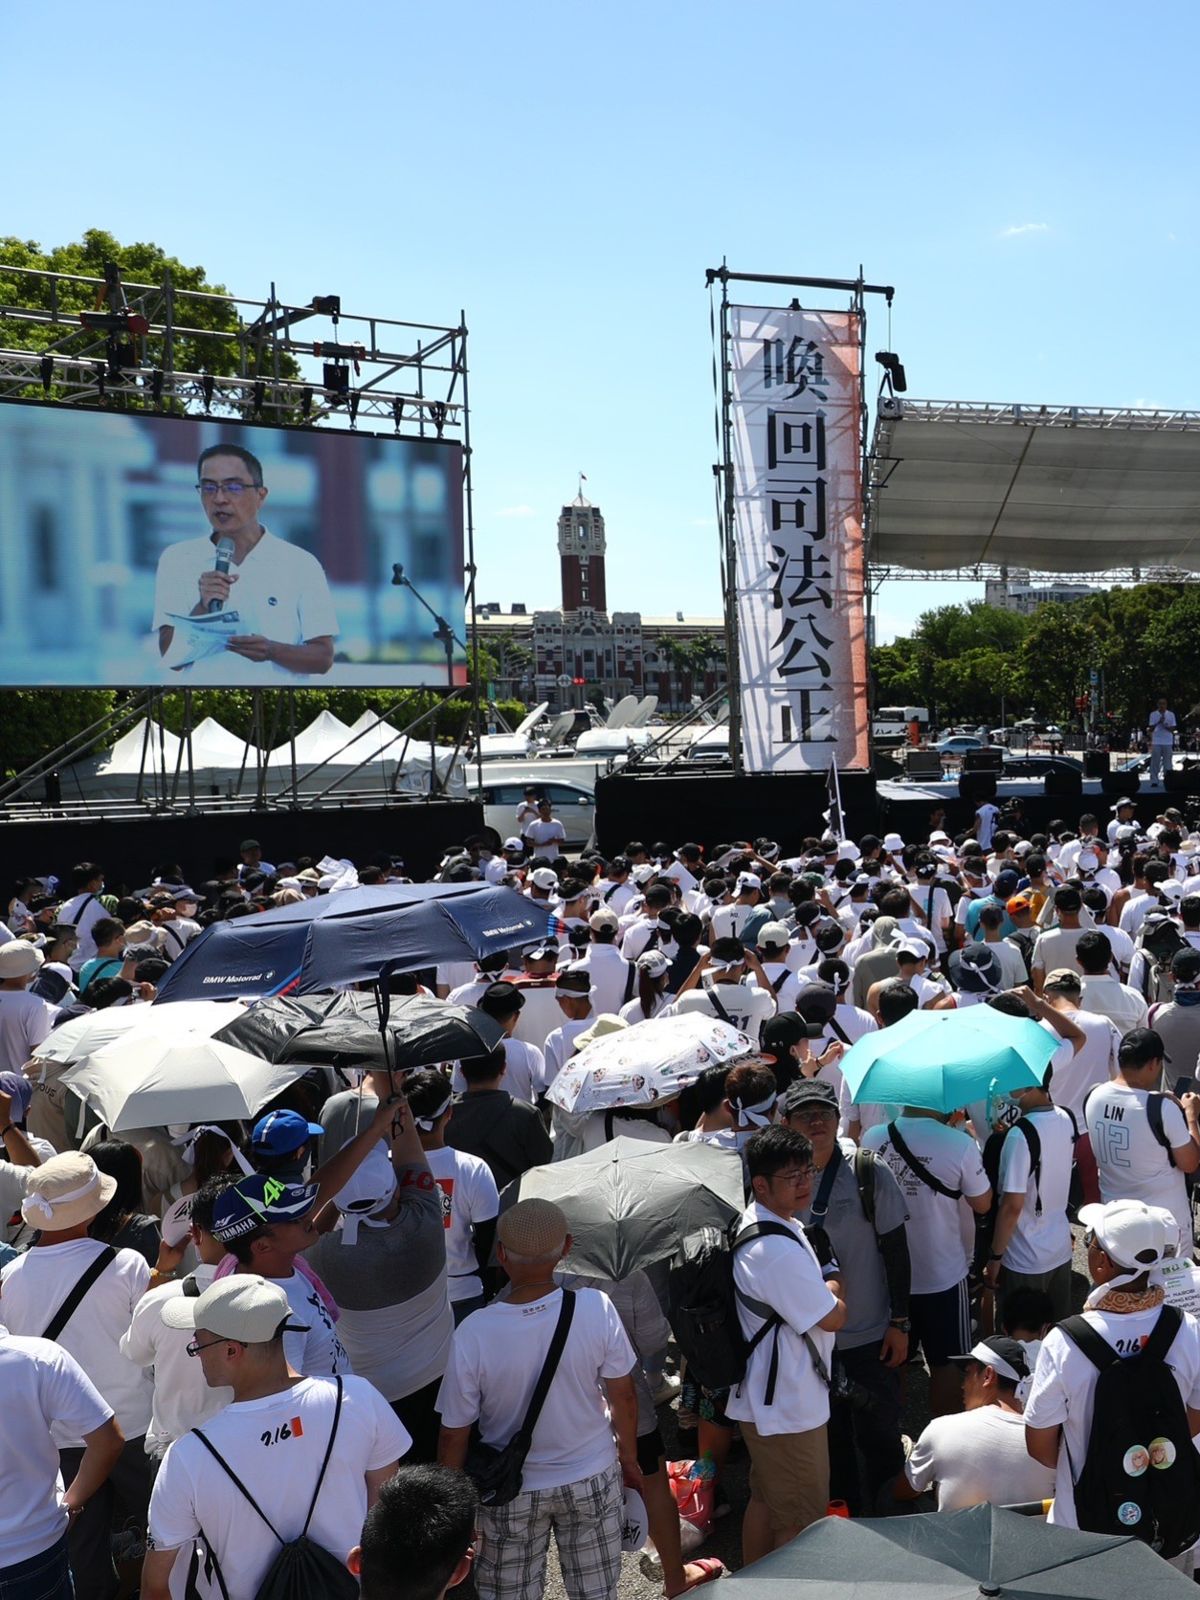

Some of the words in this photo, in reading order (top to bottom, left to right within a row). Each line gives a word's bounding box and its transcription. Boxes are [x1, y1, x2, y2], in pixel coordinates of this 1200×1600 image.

[764, 335, 837, 745] 喚回司法公正
[203, 975, 226, 984] BMW
[225, 973, 263, 983] Motorrad
[1104, 1104, 1124, 1121] LIN
[1095, 1120, 1131, 1168] 12
[222, 1217, 257, 1241] YAMAHA
[1185, 1293, 1200, 1301] KONG
[1116, 1338, 1140, 1354] 7.16
[261, 1423, 292, 1446] 7.16
